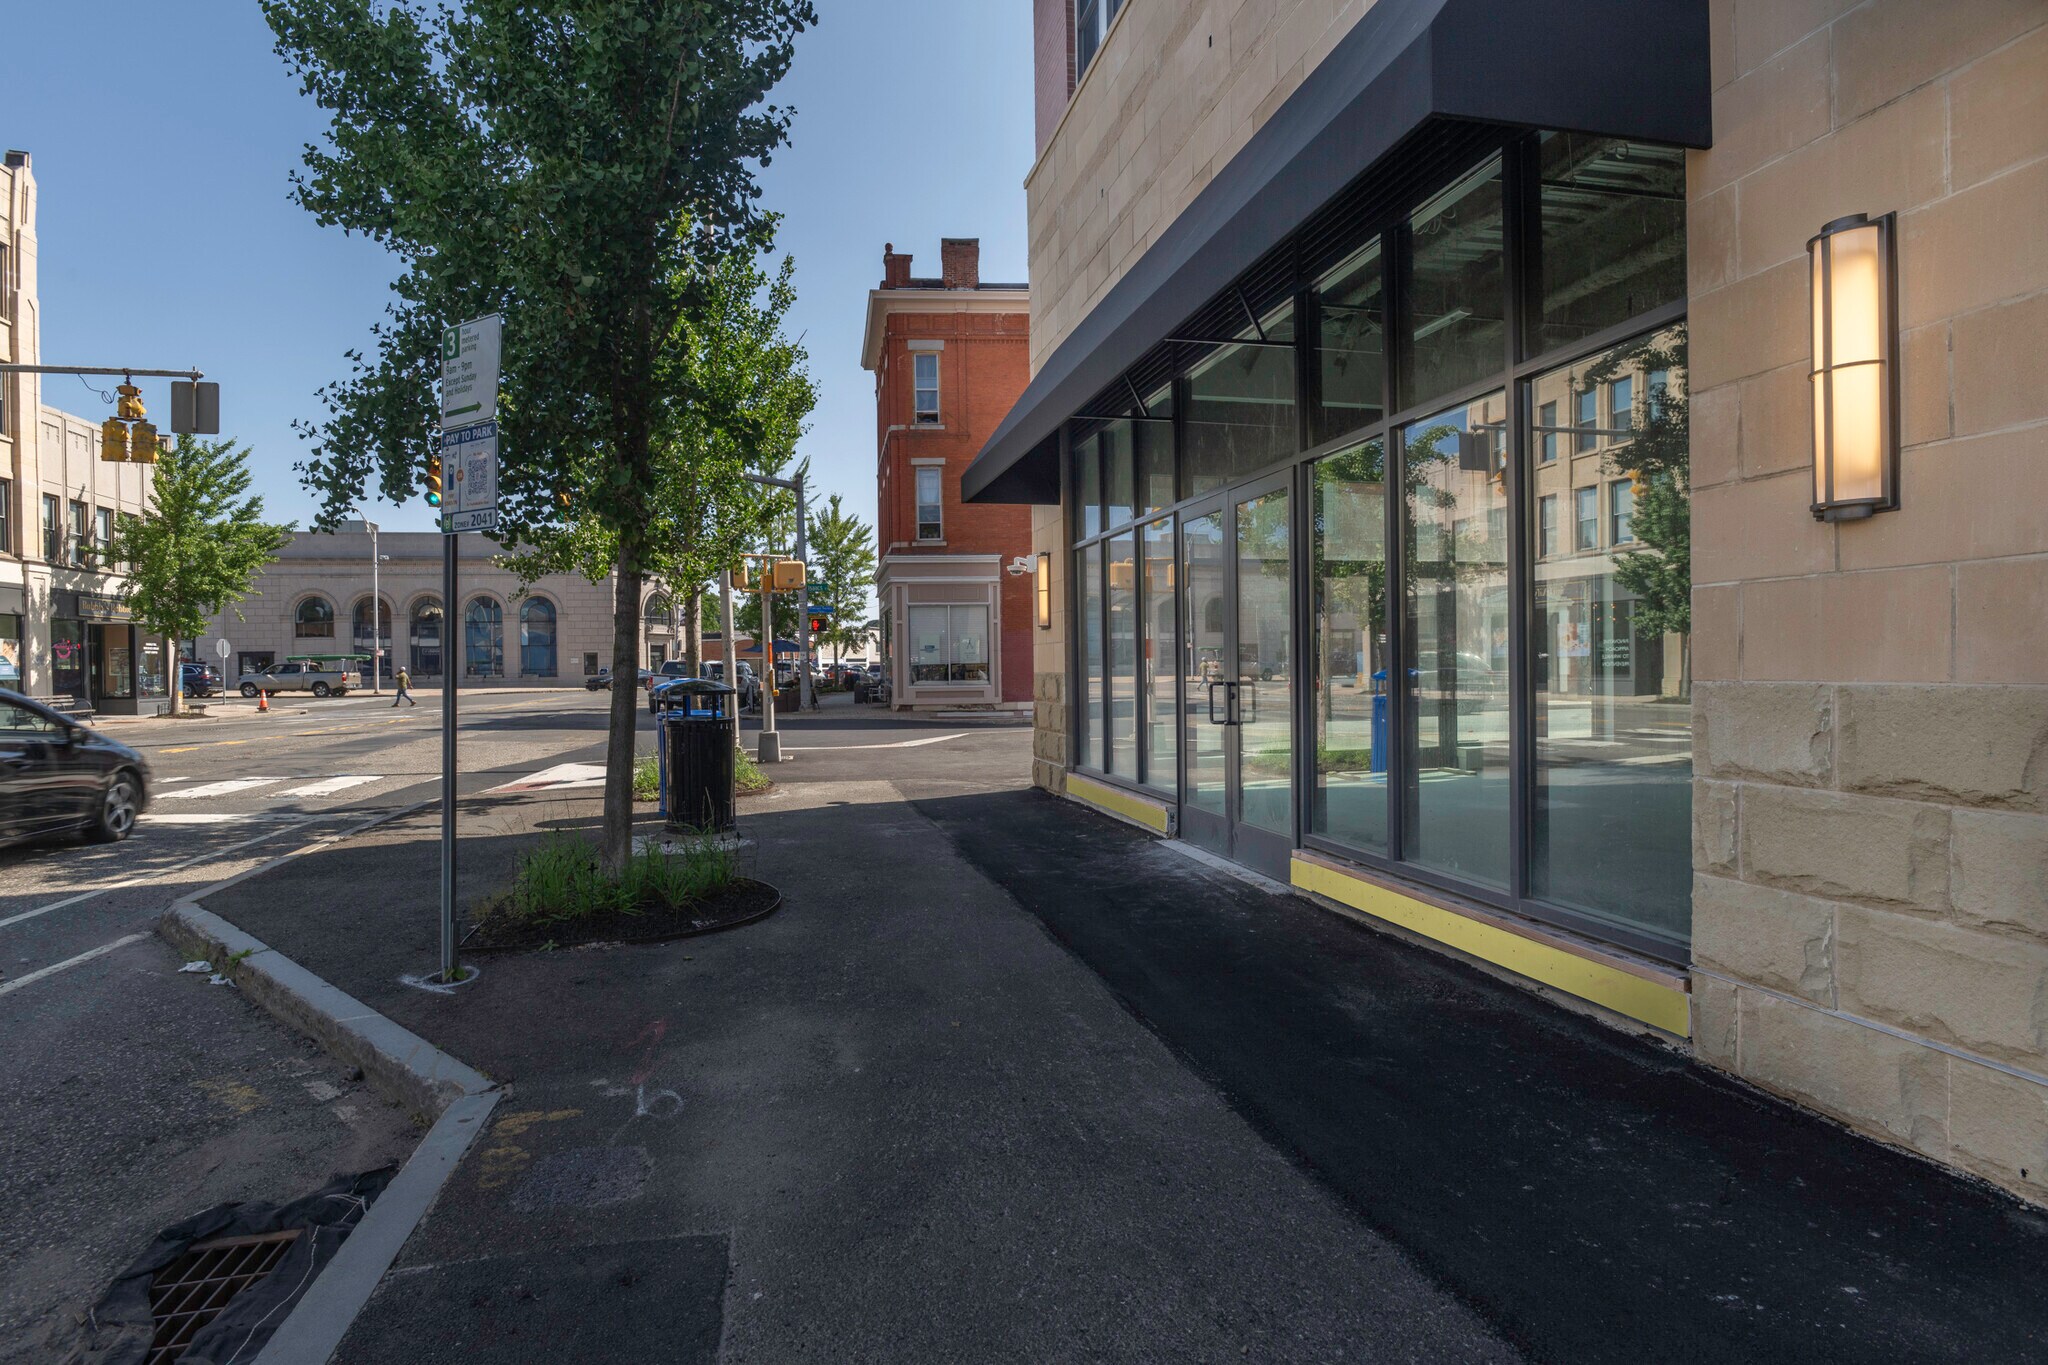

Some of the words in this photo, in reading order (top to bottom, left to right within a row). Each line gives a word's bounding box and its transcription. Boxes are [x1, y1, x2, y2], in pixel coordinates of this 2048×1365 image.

[462, 327, 471, 335] hour
[447, 331, 456, 357] 3
[461, 333, 479, 344] metered
[461, 343, 477, 354] parking
[446, 365, 457, 375] 9am
[461, 361, 473, 372] 9pm
[446, 375, 460, 387] Except
[461, 372, 477, 383] Sunday
[446, 388, 454, 398] and
[455, 384, 472, 395] Holidays
[445, 432, 460, 446] PAY
[460, 430, 471, 441] TO
[473, 426, 493, 440] PARK
[471, 513, 493, 527] 2041
